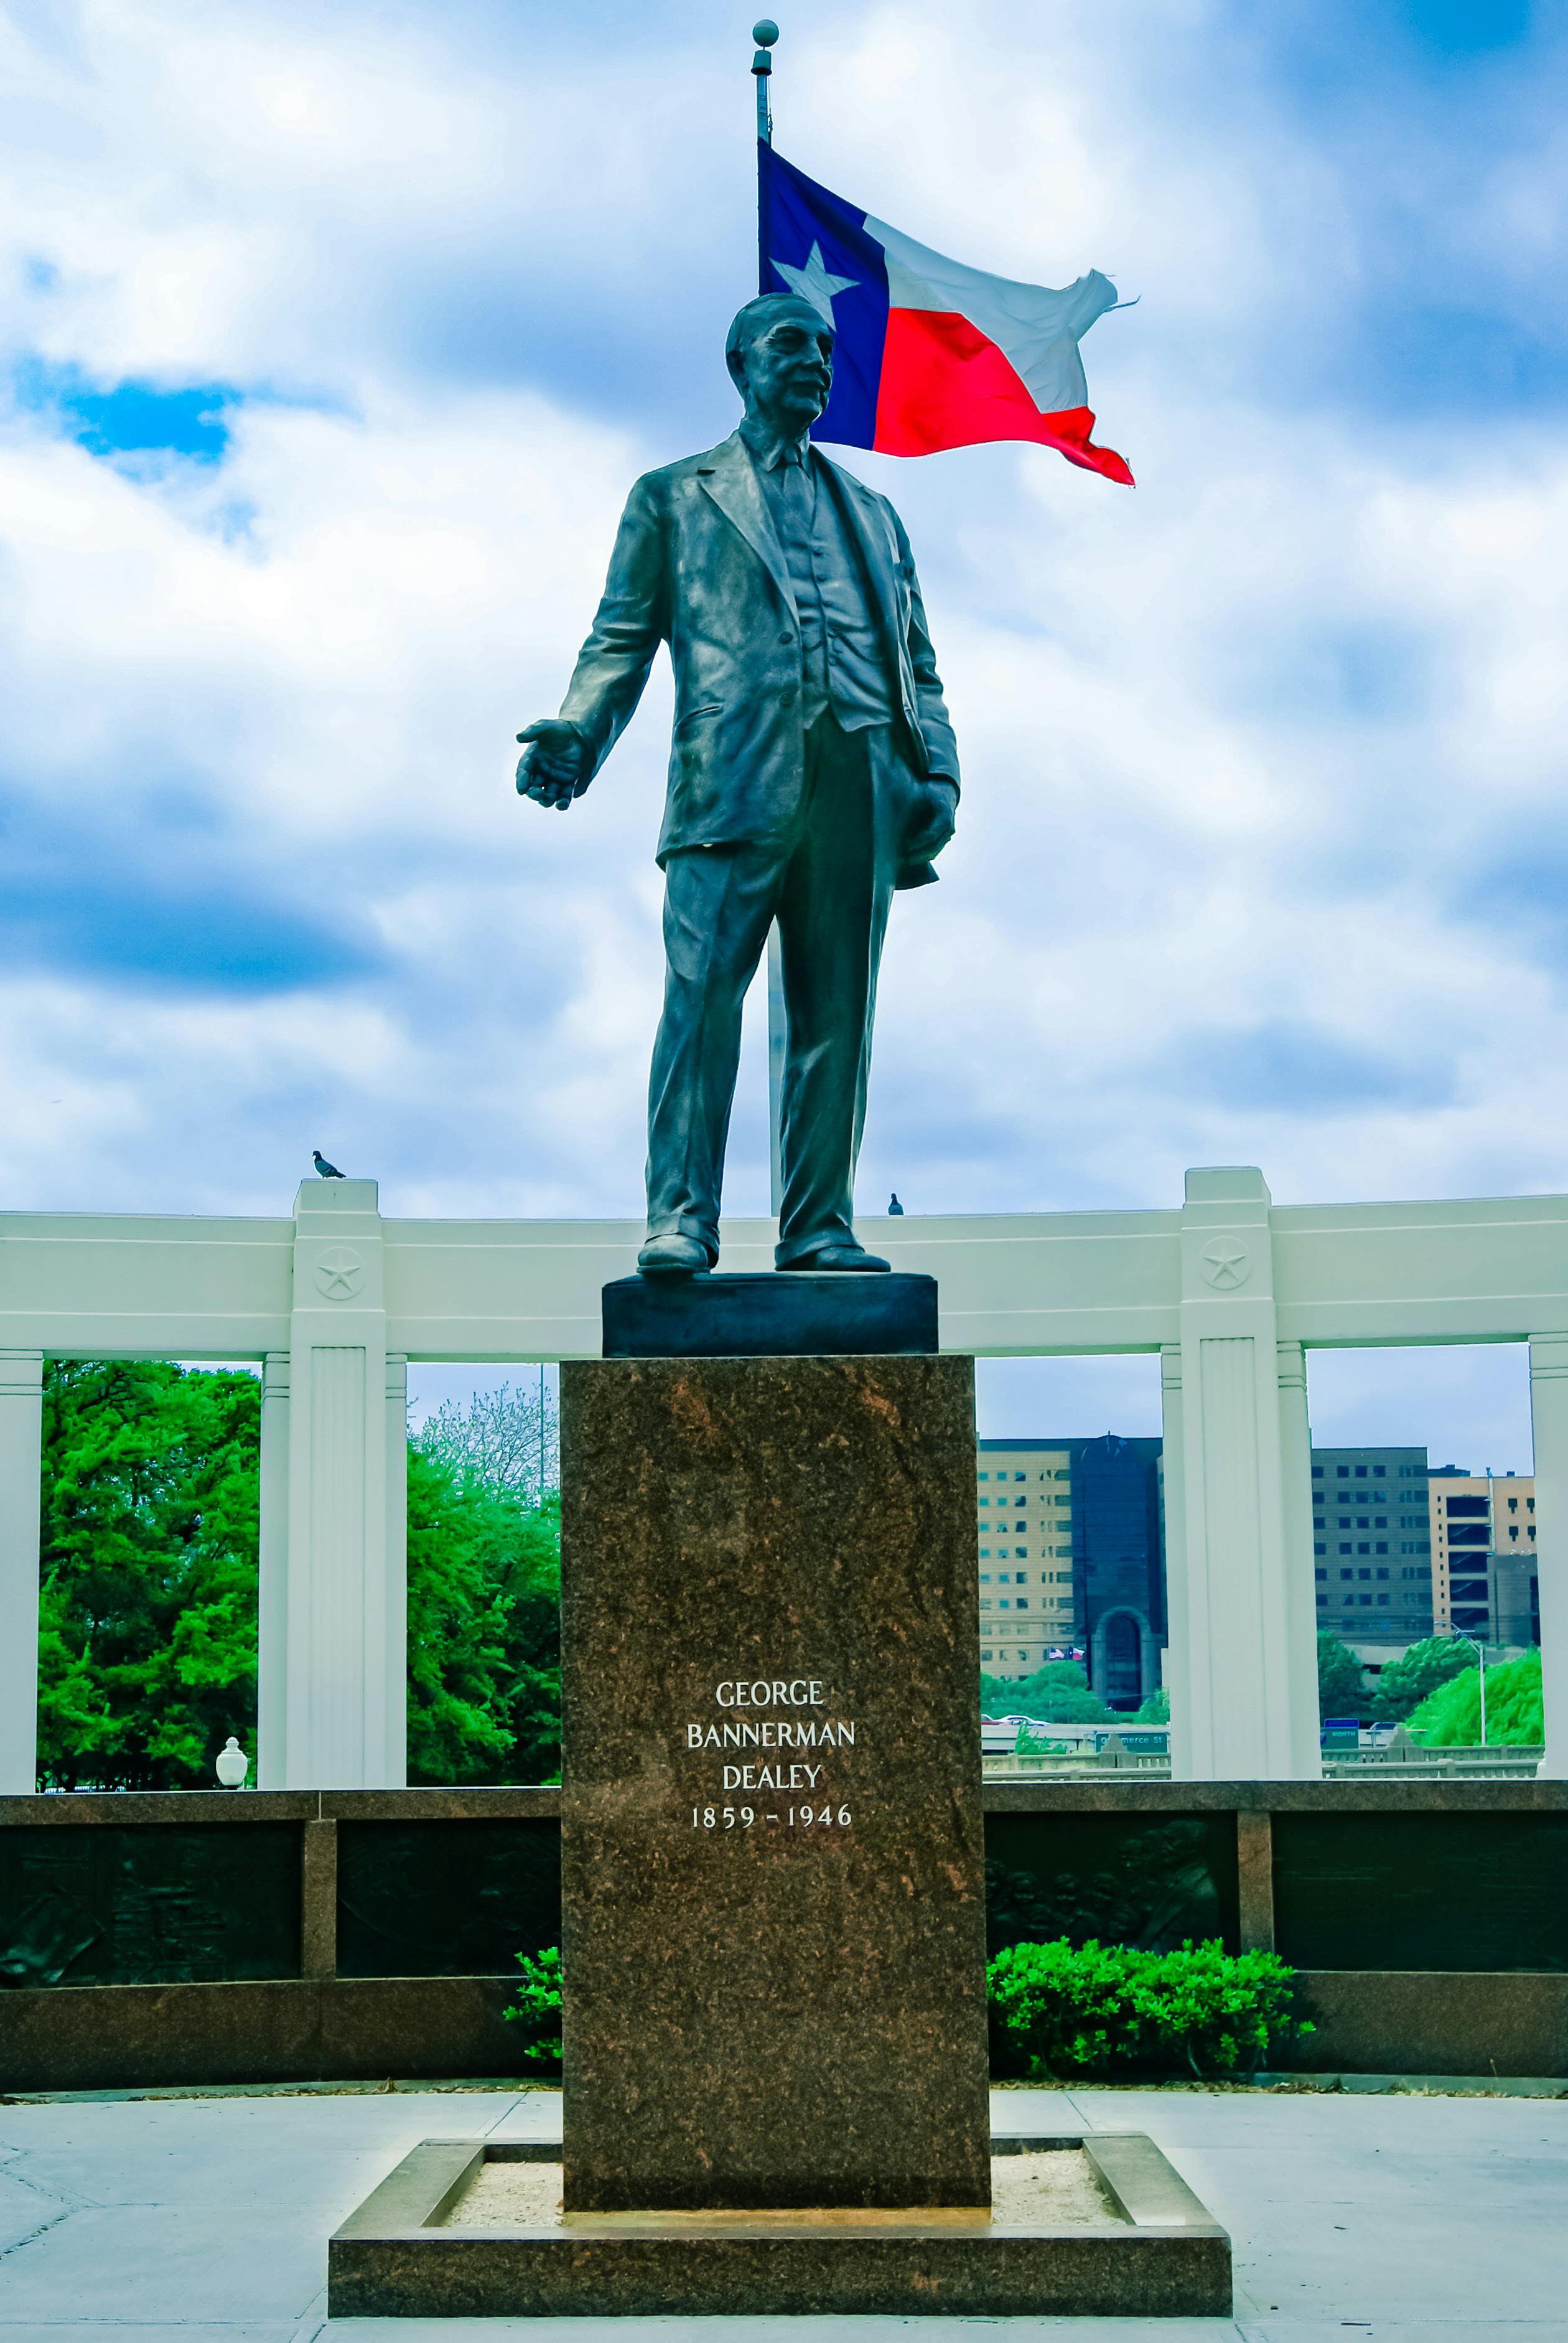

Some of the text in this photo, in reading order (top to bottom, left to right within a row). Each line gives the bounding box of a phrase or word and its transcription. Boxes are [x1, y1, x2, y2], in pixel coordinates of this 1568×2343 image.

[716, 1680, 824, 1707] GEORGE
[687, 1722, 855, 1748] BANNERMAN
[723, 1764, 822, 1790] DEALEY
